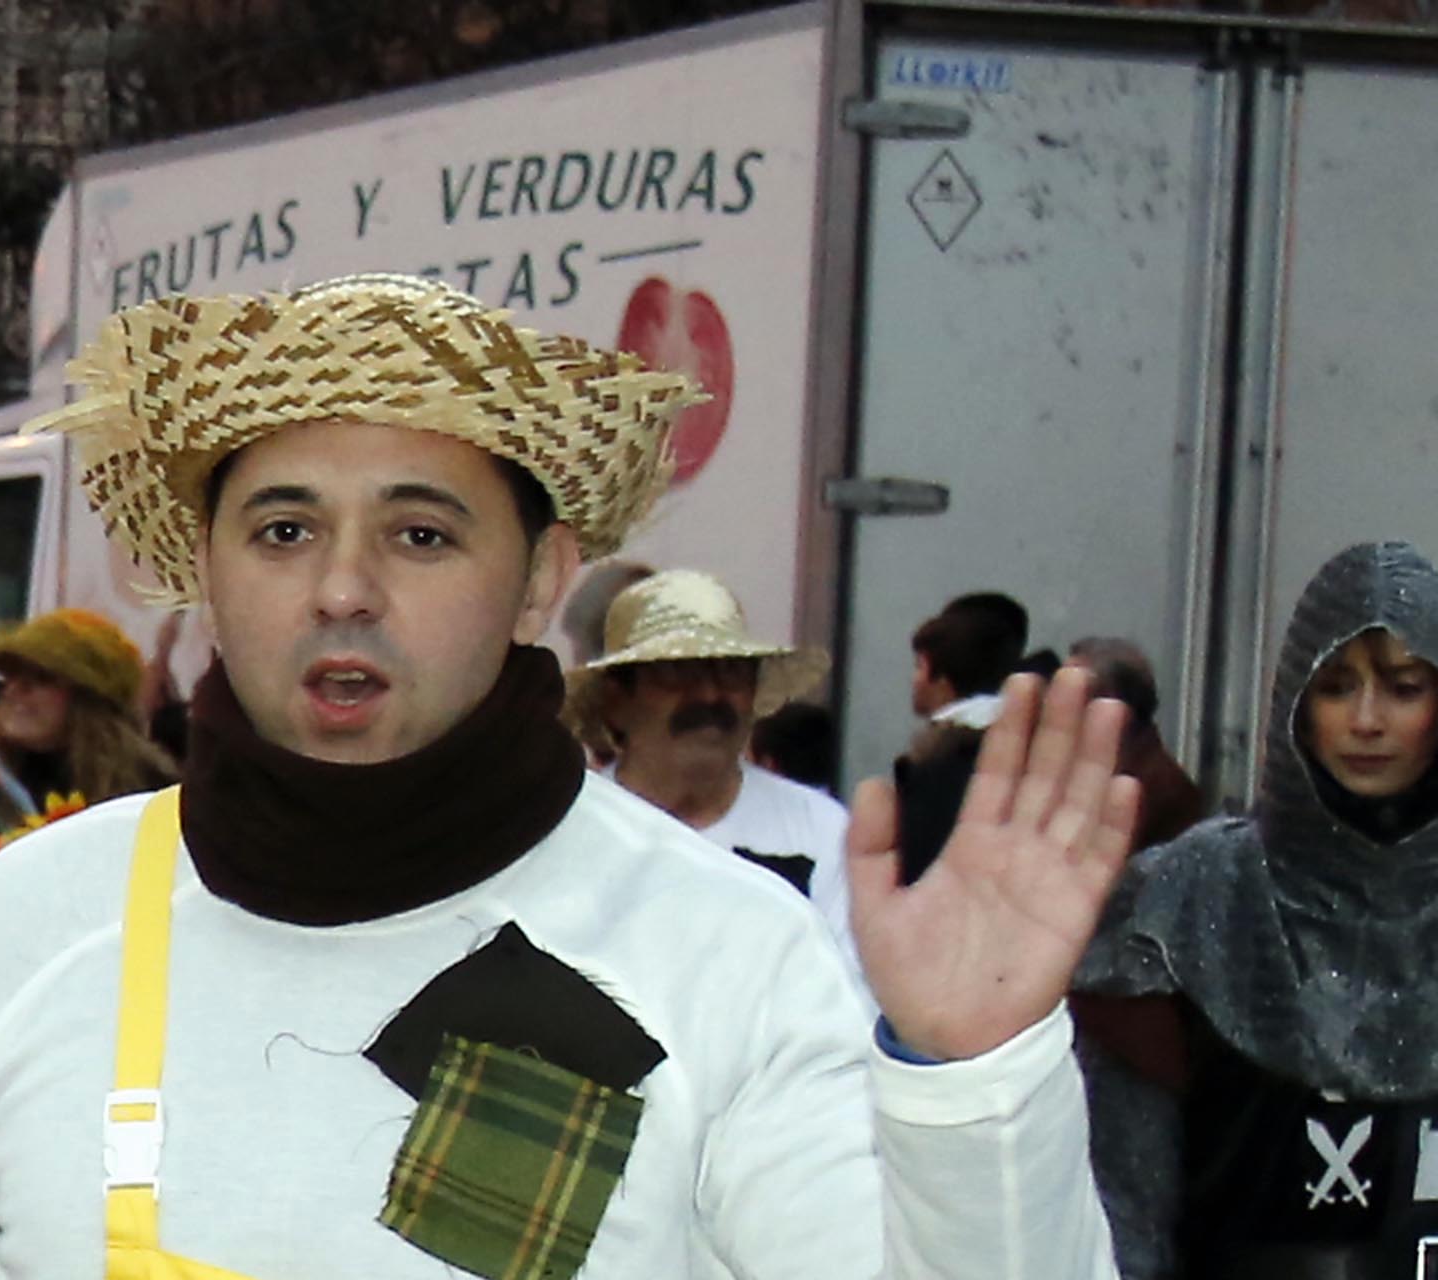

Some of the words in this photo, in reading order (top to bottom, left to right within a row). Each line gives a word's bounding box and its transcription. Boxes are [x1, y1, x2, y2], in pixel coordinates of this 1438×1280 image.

[111, 200, 299, 313] FRUTAS
[353, 178, 383, 238] Y
[441, 149, 765, 225] VERDURAS
[419, 241, 584, 309] TAS
